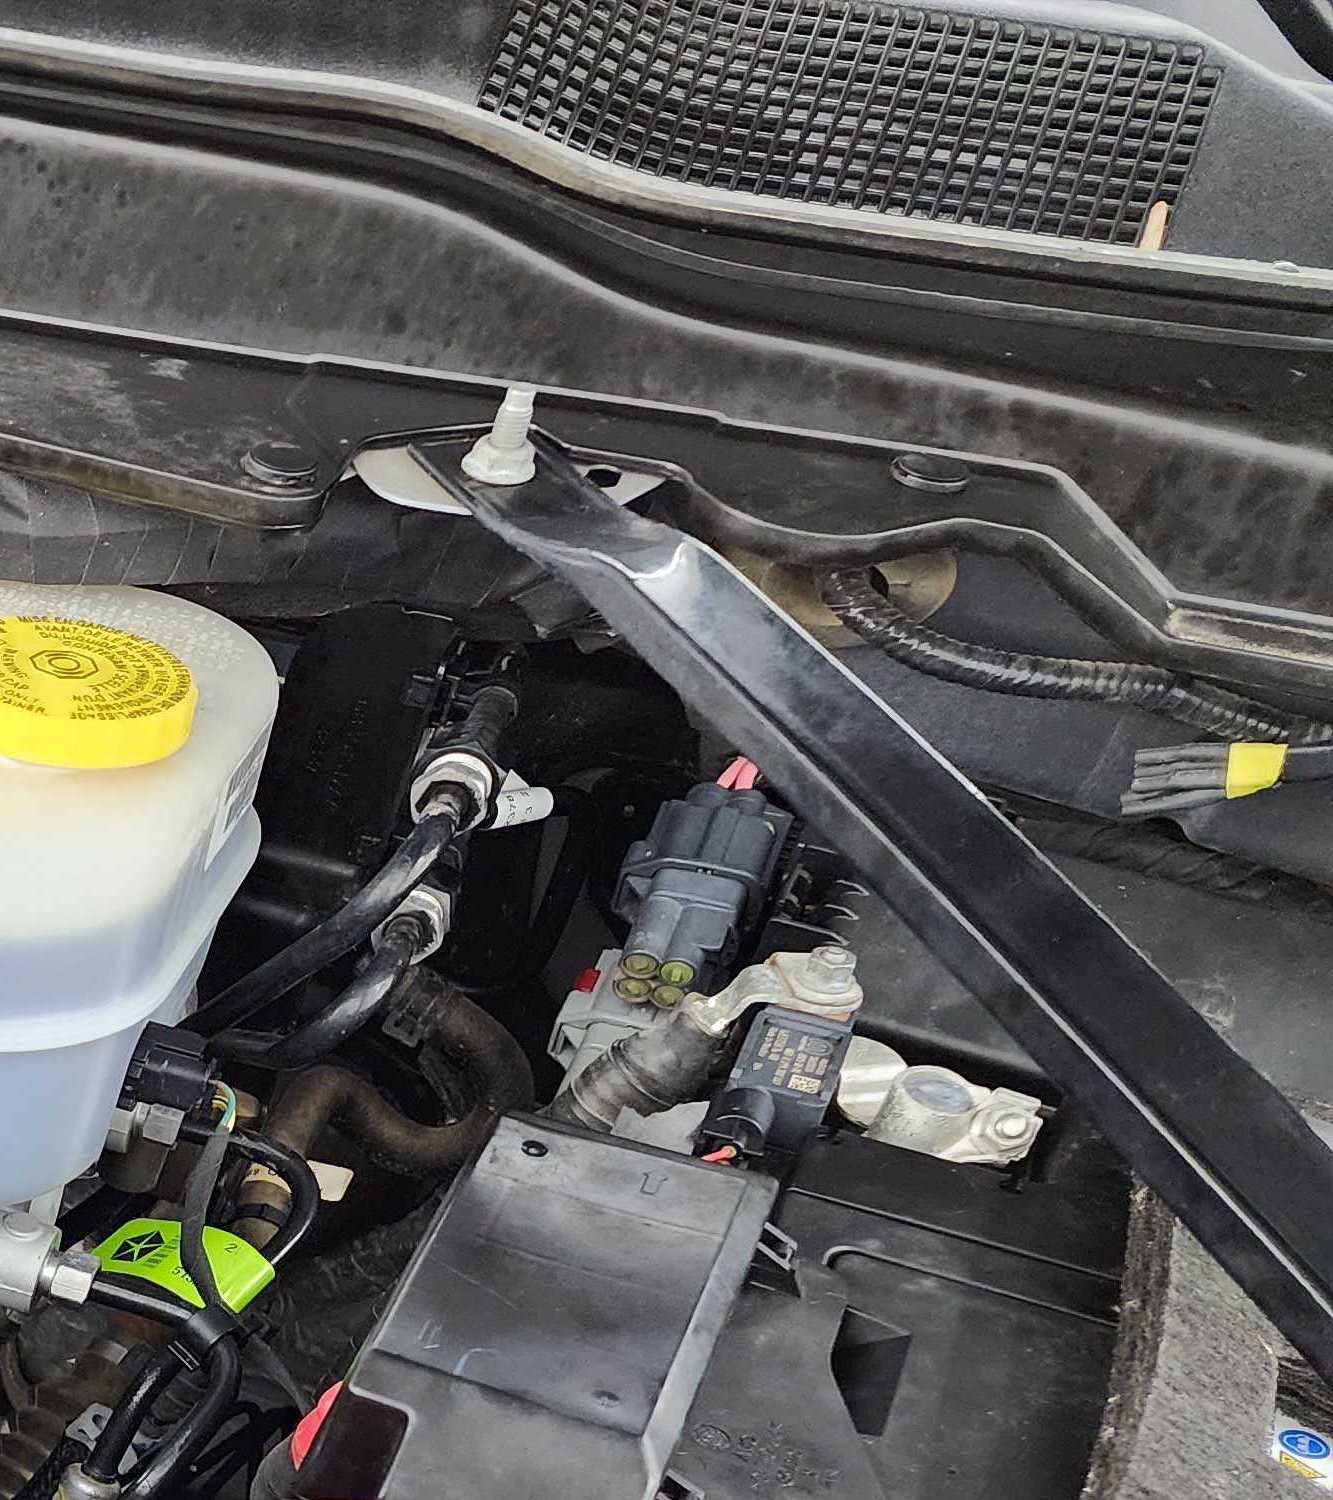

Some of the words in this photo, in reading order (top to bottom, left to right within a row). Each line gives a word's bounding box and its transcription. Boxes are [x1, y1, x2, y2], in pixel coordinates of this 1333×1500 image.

[31, 624, 78, 633] AVANT
[54, 616, 72, 625] EN
[126, 633, 182, 664] NETTOYER
[63, 633, 118, 650] LIQUIDE
[114, 649, 142, 662] DOT
[61, 639, 132, 673] CONTENANT
[0, 678, 31, 691] CAP
[2, 689, 40, 704] ONLY
[224, 1243, 238, 1254] 2
